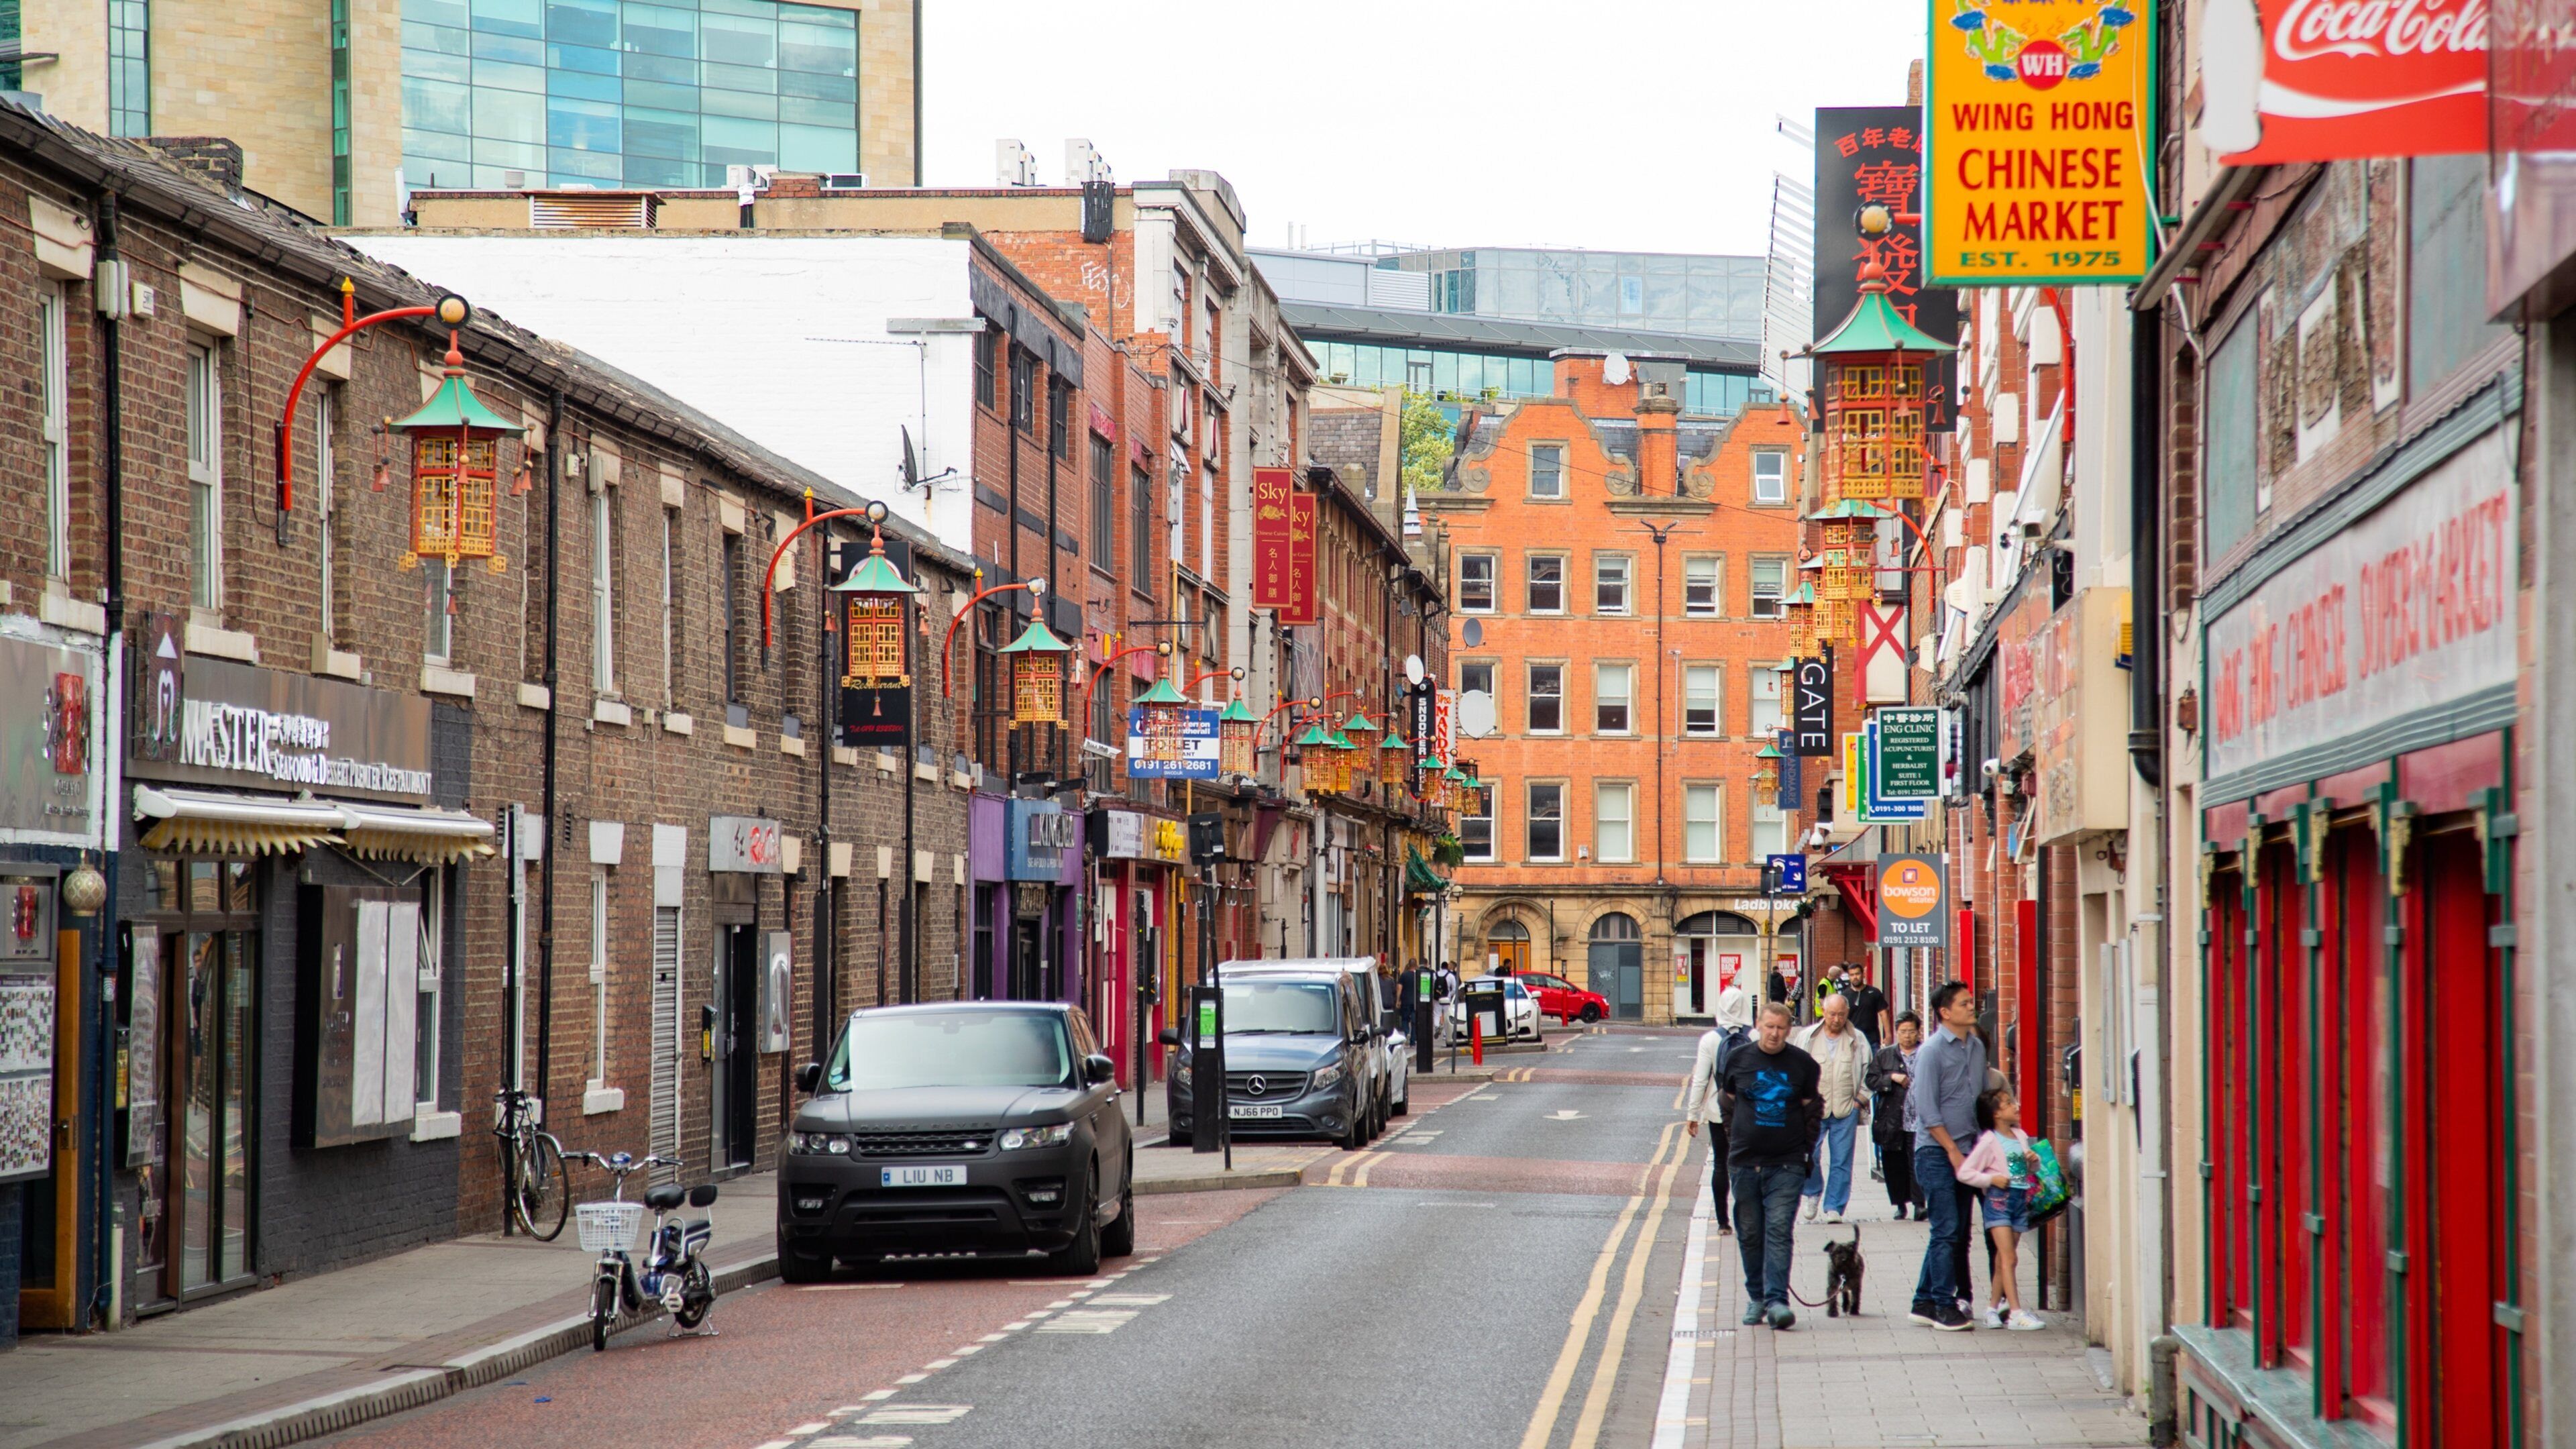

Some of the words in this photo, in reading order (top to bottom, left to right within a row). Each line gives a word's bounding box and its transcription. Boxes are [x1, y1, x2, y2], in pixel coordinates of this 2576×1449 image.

[2021, 54, 2064, 76] WH
[1951, 103, 2033, 131] WING
[2051, 101, 2133, 130] HONG
[1958, 148, 2122, 190] CHINESE
[1964, 200, 2124, 241] MARKET
[1960, 252, 2029, 267] EST.
[2045, 251, 2121, 266] 1975
[1258, 482, 1287, 504] Sky
[1292, 506, 1310, 527] ky
[2286, 582, 2347, 710] CHINESE
[2359, 488, 2510, 680] SUPERMARKET
[1436, 694, 1452, 704] The
[1801, 663, 1826, 747] GATE
[179, 698, 273, 774] MASTER
[1419, 698, 1427, 755] SNOOKER
[1884, 724, 1902, 733] ENG
[1904, 724, 1935, 733] CLINIC
[1163, 761, 1182, 769] 261
[1185, 761, 1212, 769] 2681
[1884, 884, 1935, 896] bowson
[1890, 922, 1908, 932] TO
[1910, 923, 1931, 932] LET
[1234, 1108, 1258, 1116] NJ66
[1260, 1107, 1279, 1116] PPO
[932, 1122, 992, 1130] ROVER
[934, 1169, 953, 1182] NB
